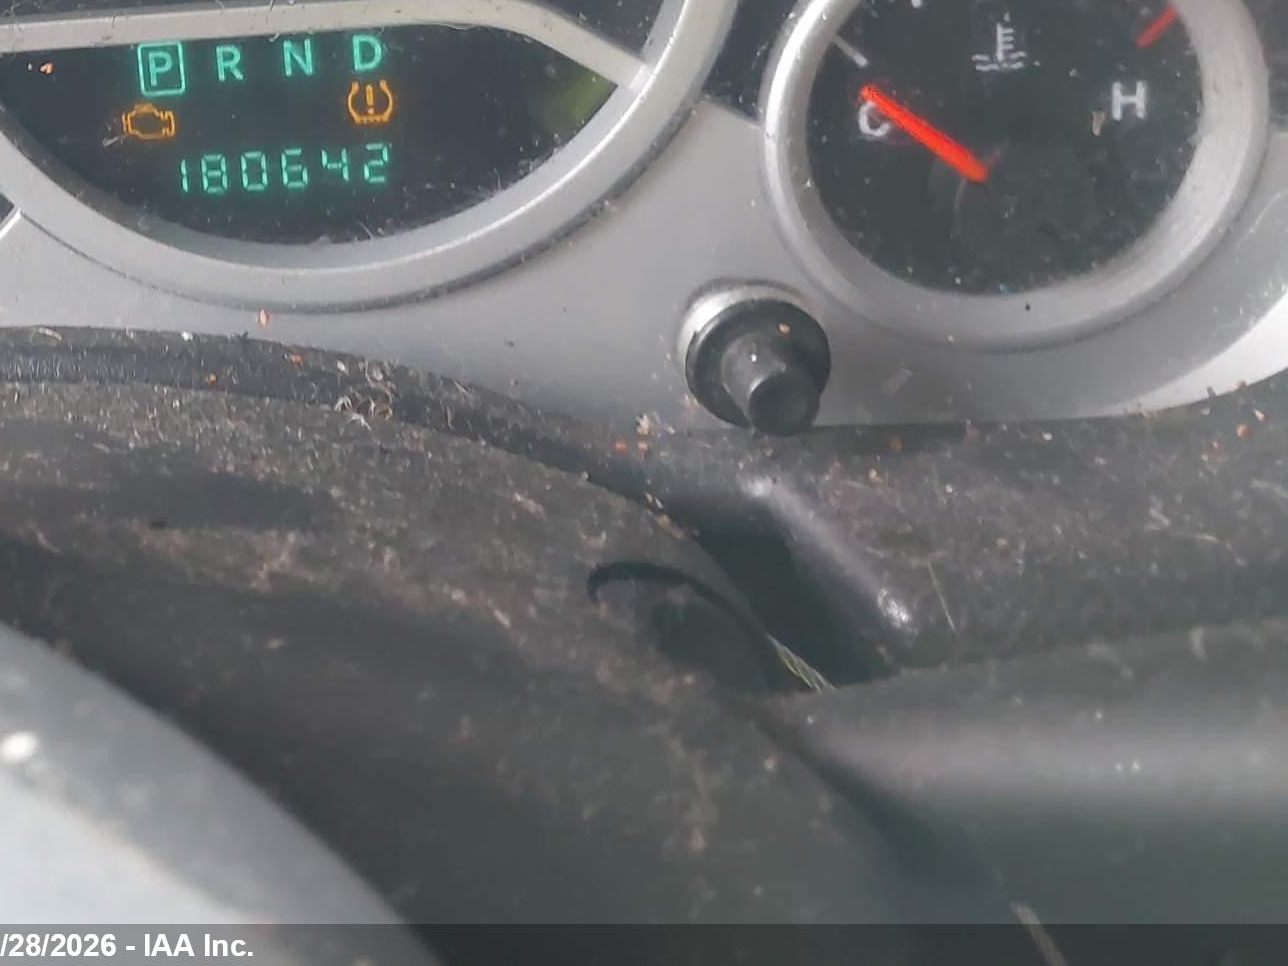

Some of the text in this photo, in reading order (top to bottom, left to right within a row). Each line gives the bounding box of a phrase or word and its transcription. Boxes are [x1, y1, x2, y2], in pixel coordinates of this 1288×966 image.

[148, 34, 383, 86] P R N D
[858, 101, 891, 138] C
[1112, 81, 1147, 121] H
[179, 142, 390, 194] 180642
